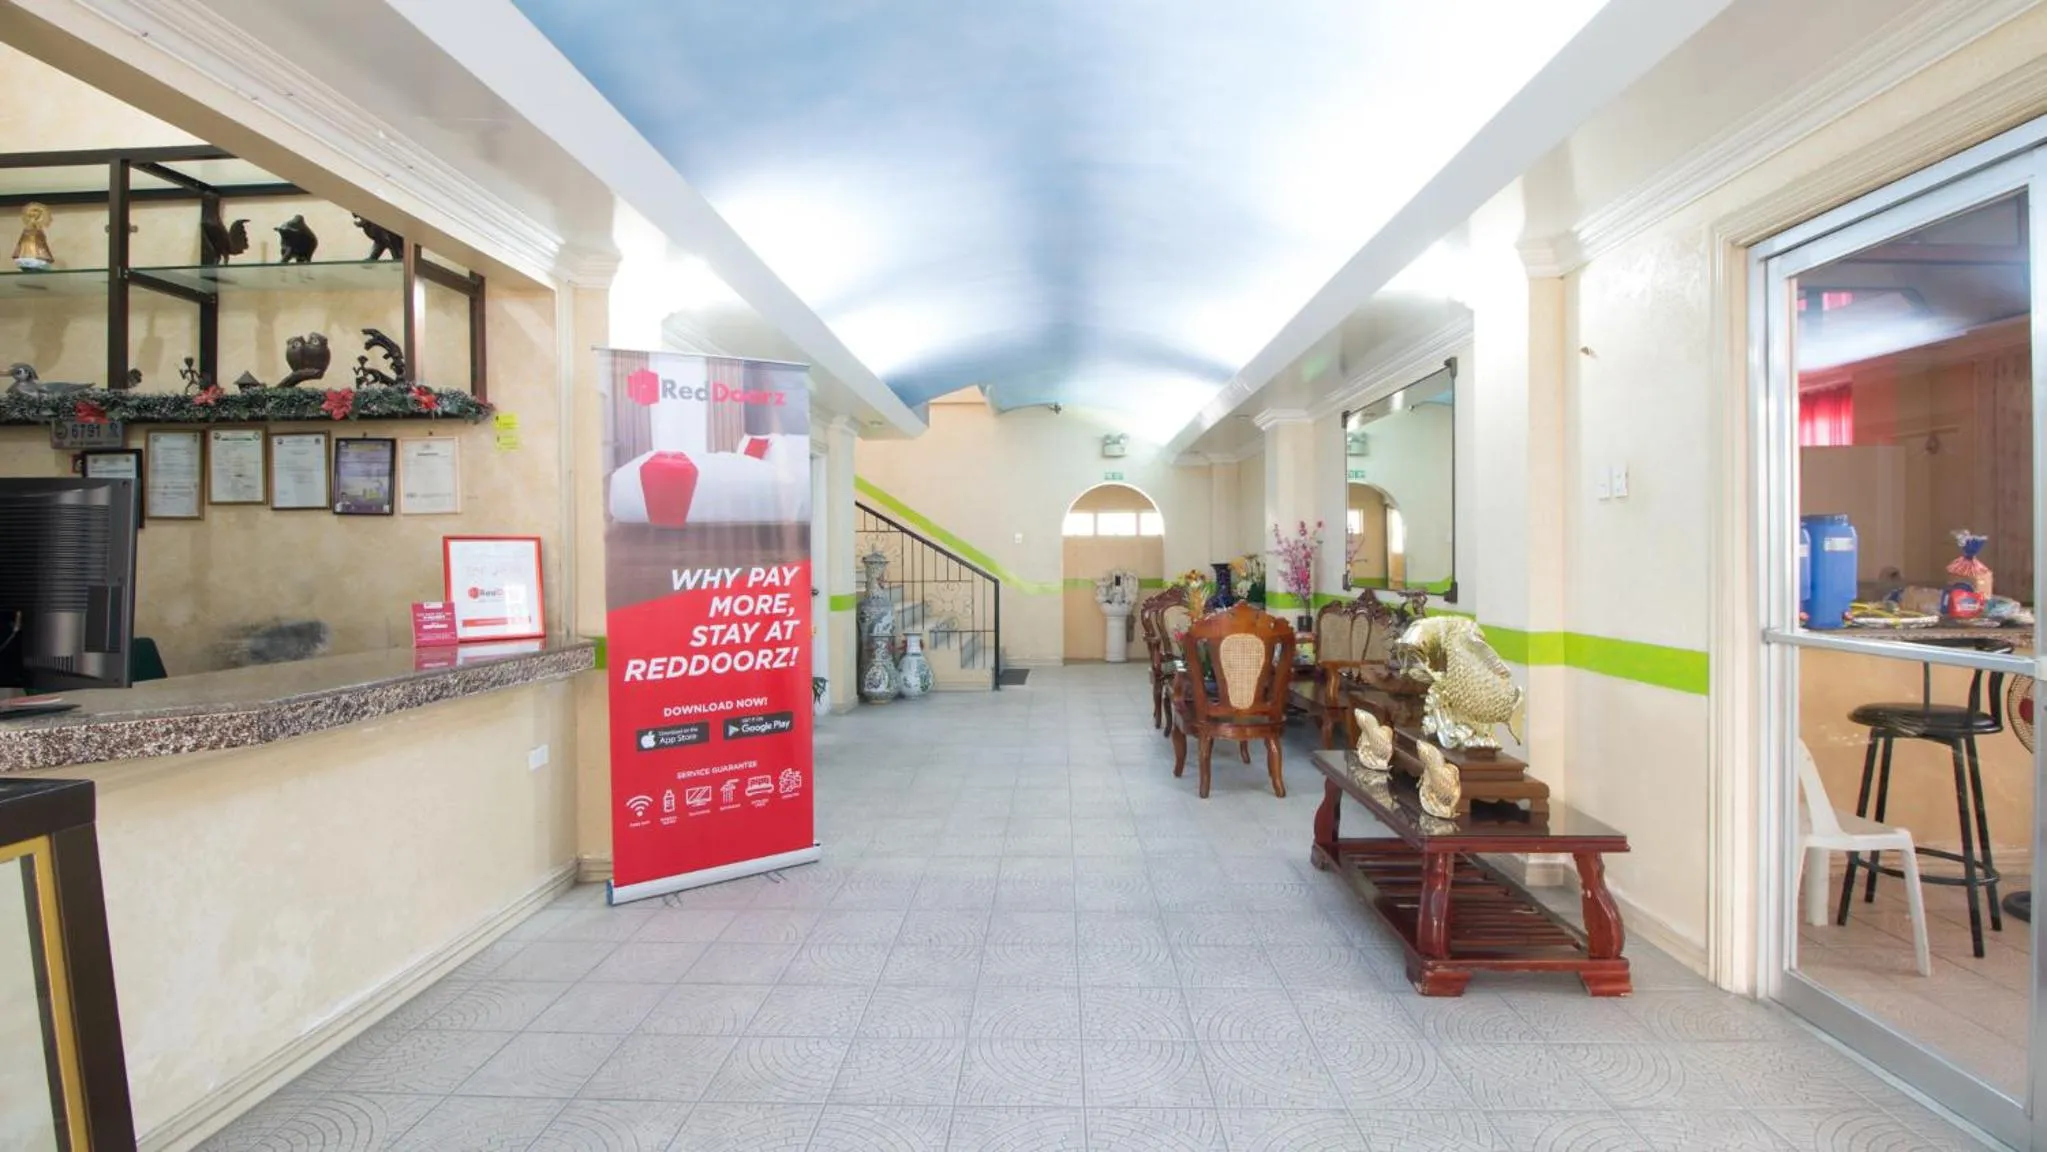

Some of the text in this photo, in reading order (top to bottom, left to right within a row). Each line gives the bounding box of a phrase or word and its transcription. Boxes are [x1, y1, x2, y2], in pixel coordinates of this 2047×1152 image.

[662, 379, 786, 407] RedDoorz
[672, 566, 800, 591] WHY PAY
[709, 595, 795, 617] MORE,
[689, 620, 801, 647] STAY AT
[624, 647, 799, 682] REDDOORZ!
[664, 697, 768, 717] DOWNLOAD NOW!
[741, 720, 791, 733] Google Play
[660, 734, 697, 745] App Store
[676, 761, 758, 780] SERVICE GUARANTEE
